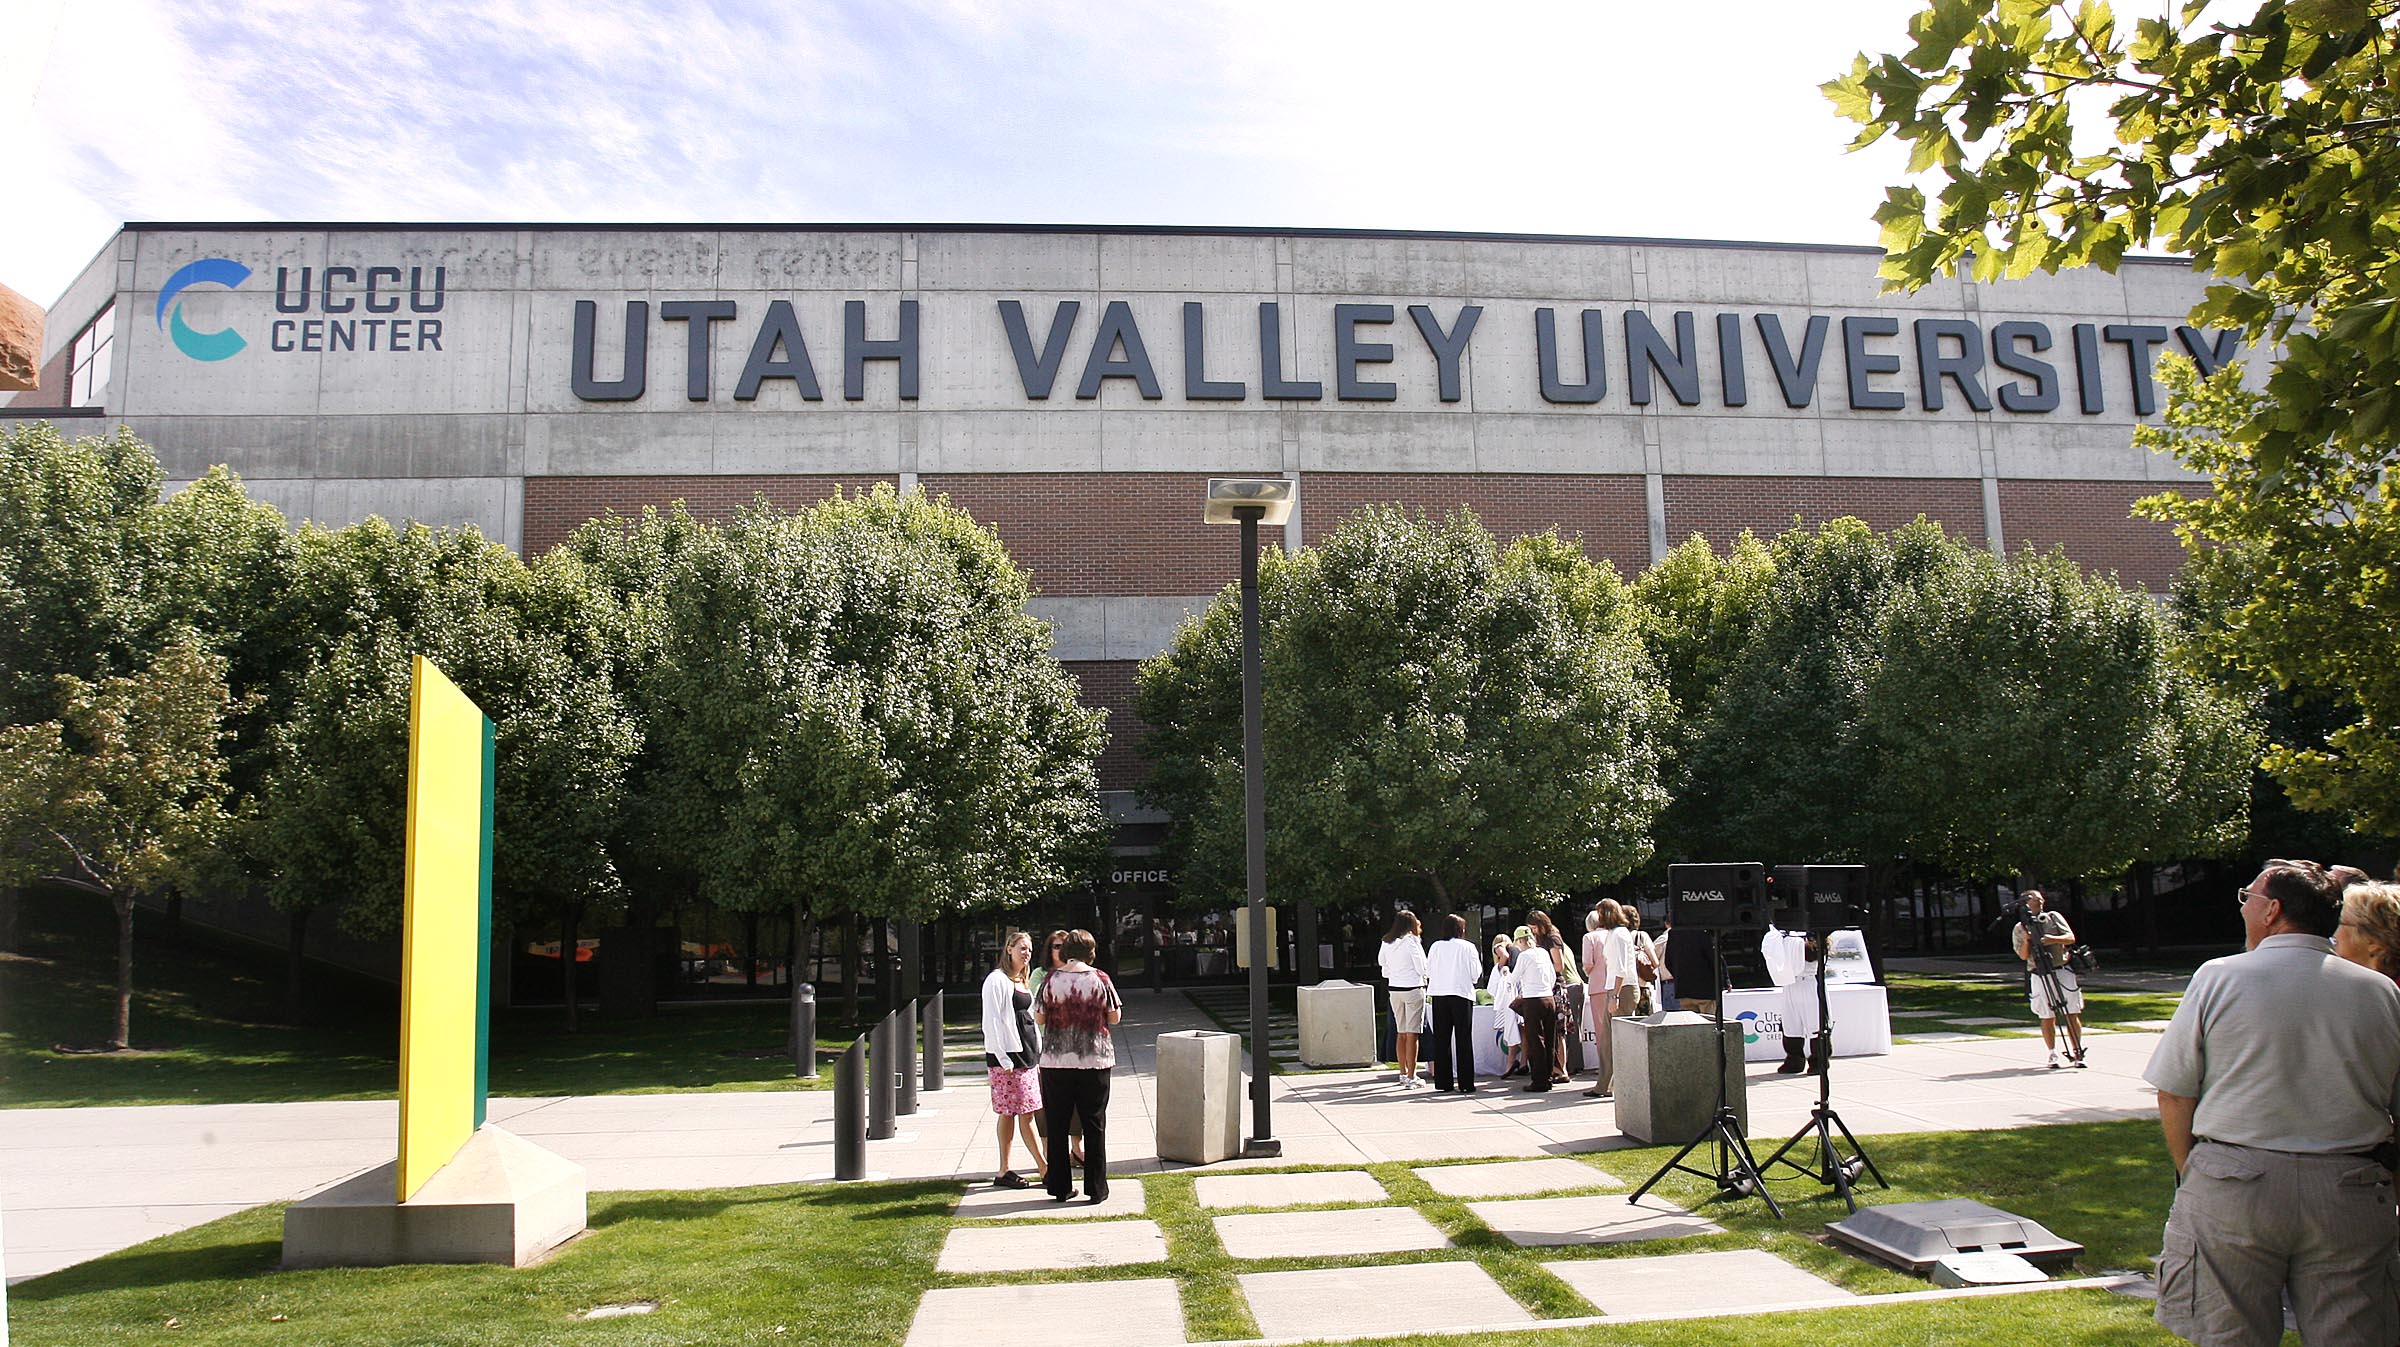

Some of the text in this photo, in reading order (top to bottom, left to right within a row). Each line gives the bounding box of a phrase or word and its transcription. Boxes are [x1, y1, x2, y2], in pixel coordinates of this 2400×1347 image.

[275, 266, 446, 313] UCCU
[271, 319, 443, 352] CENTER
[571, 299, 919, 402] UTAH
[997, 300, 1484, 402] VALLEY
[1111, 870, 1169, 883] OFFICE
[1682, 891, 1725, 901] RAMSA
[1814, 892, 1842, 903] RAMSA
